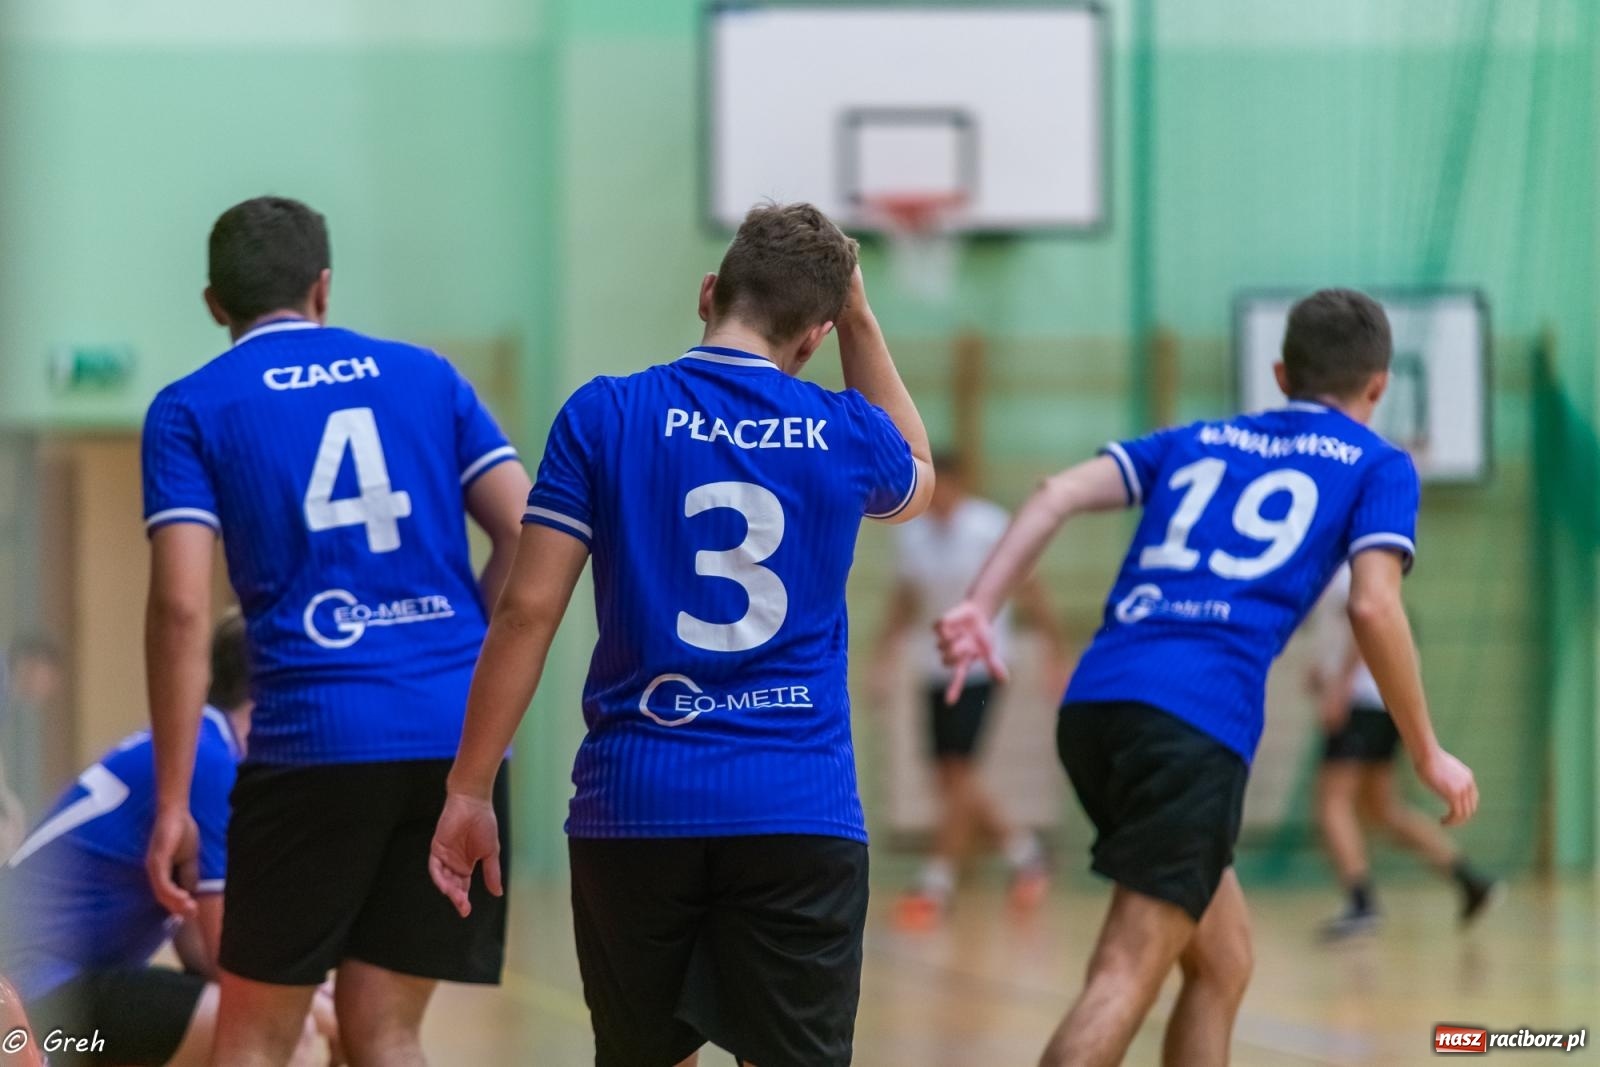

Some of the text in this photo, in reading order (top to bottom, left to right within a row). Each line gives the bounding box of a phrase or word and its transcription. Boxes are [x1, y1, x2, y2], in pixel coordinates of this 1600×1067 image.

[263, 356, 381, 392] CZACH
[664, 408, 829, 451] PŁACZEK
[304, 407, 412, 554] 4
[1138, 457, 1320, 581] 19
[676, 481, 789, 652] 3
[302, 588, 453, 649] GEO-METR
[638, 673, 812, 728] GEO-METR
[8, 763, 131, 869] 7
